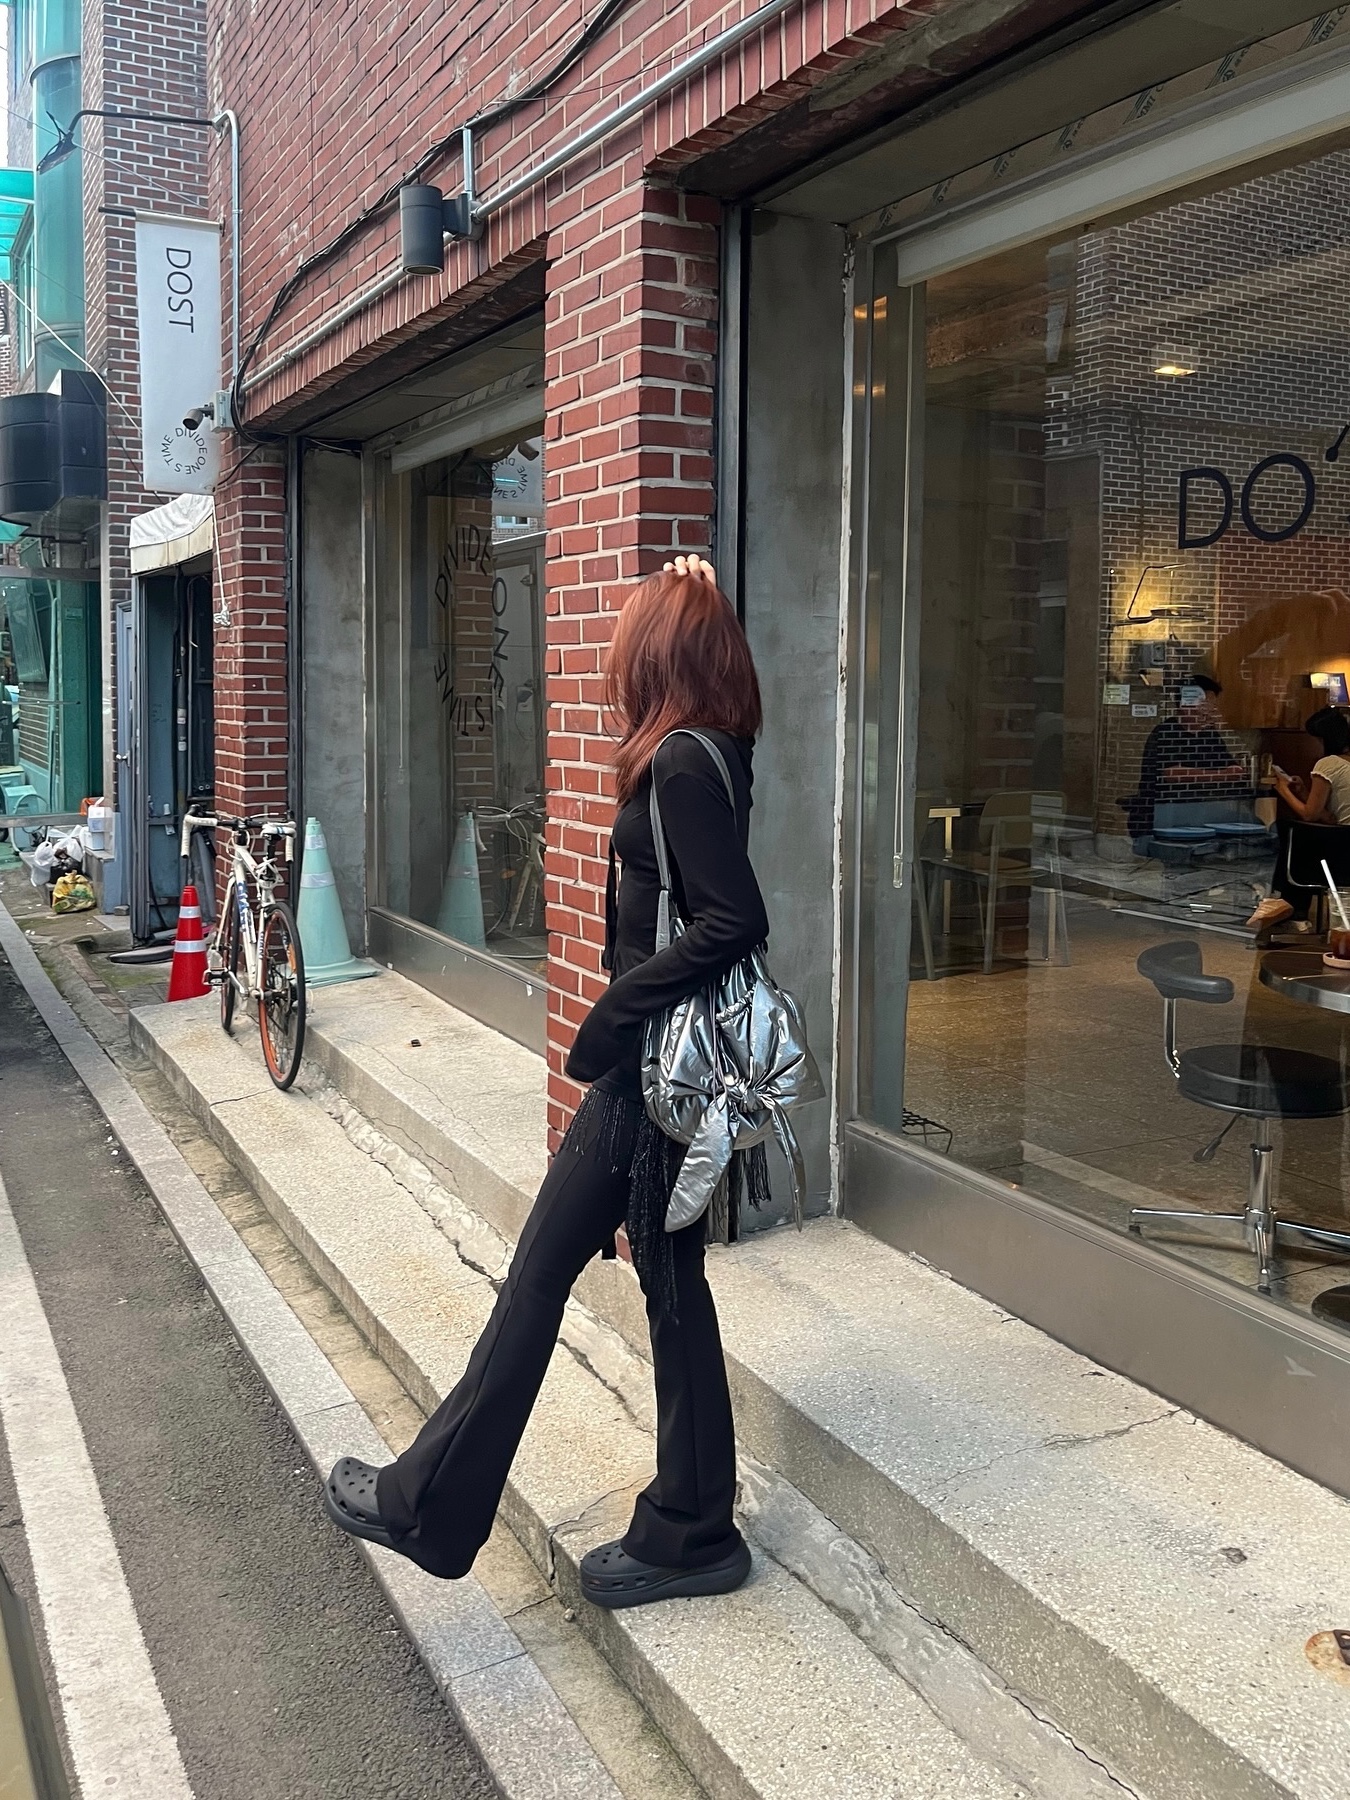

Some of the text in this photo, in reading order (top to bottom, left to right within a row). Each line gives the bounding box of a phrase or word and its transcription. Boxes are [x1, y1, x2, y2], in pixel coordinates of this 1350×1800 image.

[166, 247, 194, 334] DOST
[161, 434, 174, 466] TIME
[175, 427, 208, 454] DIVIDE
[1179, 453, 1350, 549] DO
[434, 523, 491, 609] DIVIDE
[434, 652, 469, 737] TIME
